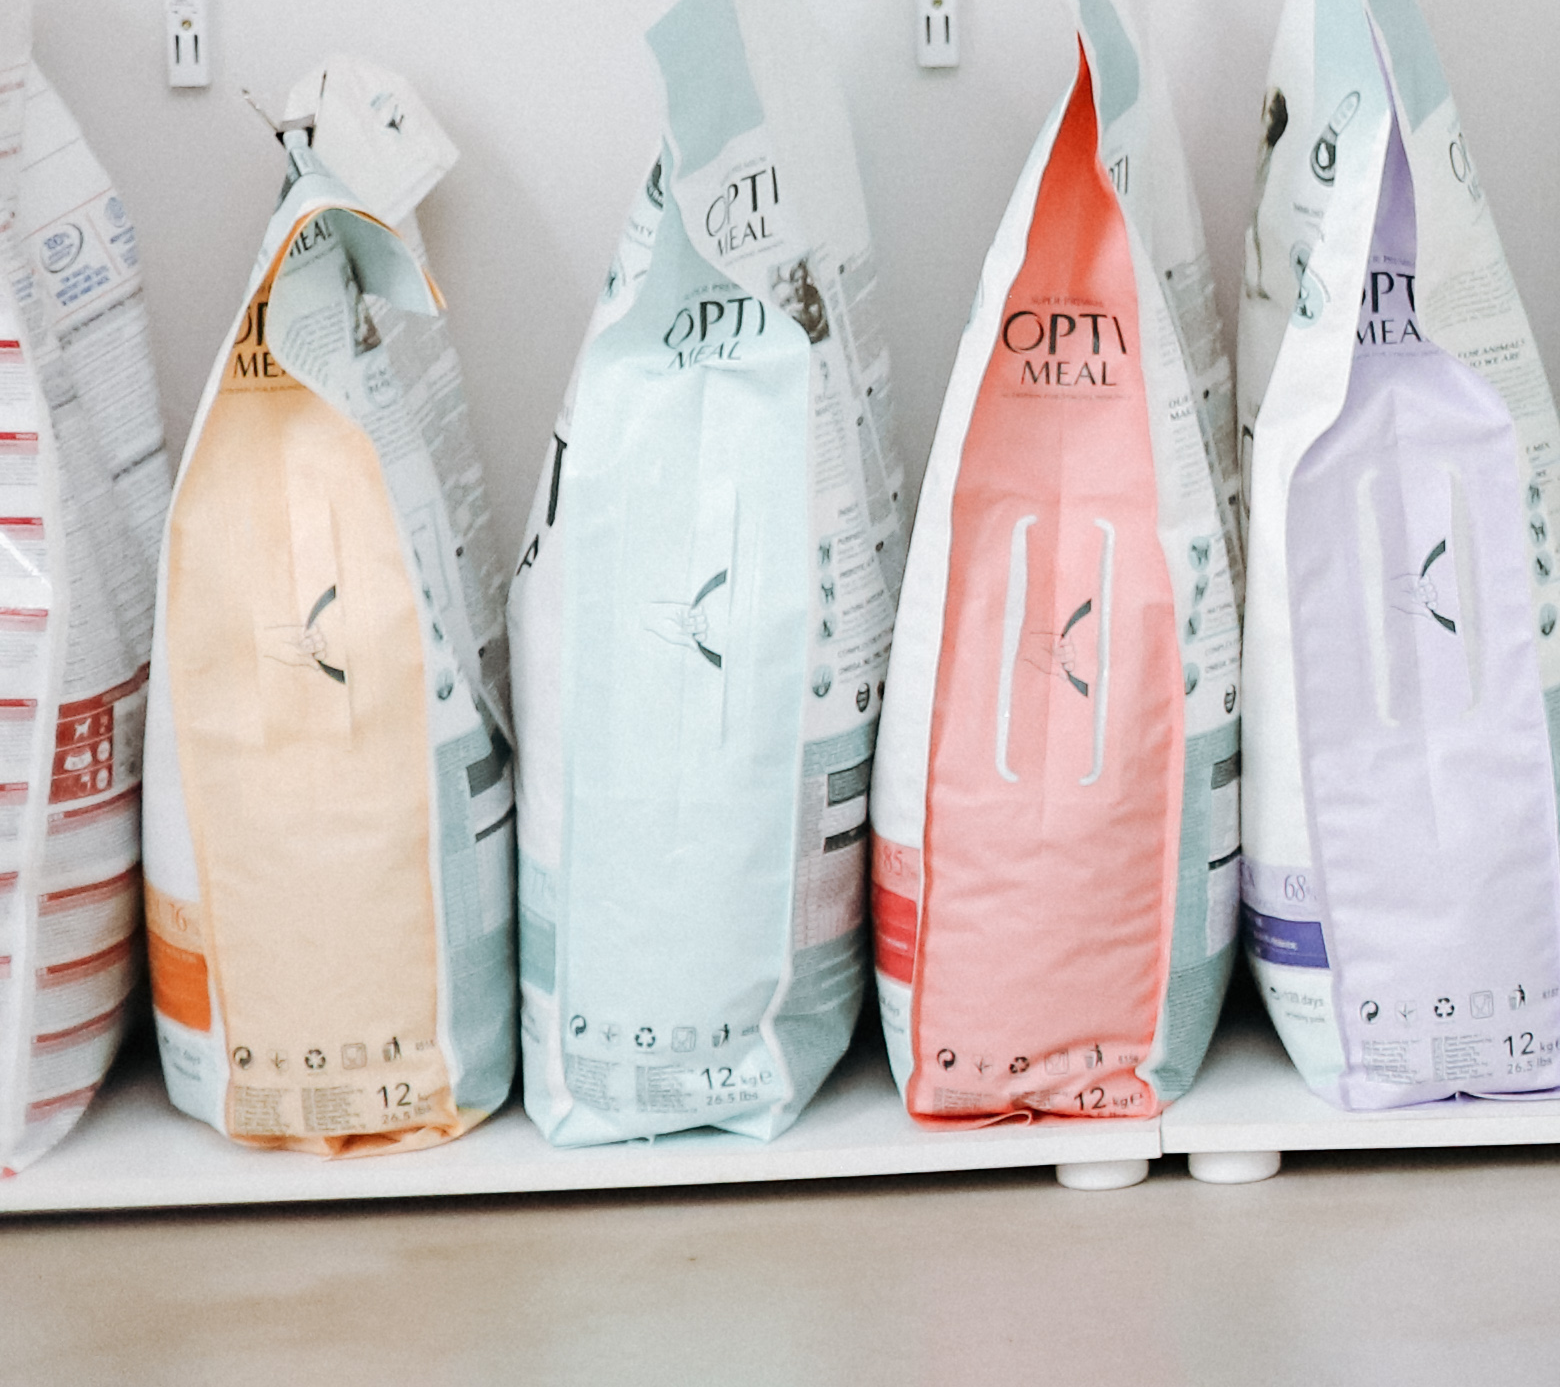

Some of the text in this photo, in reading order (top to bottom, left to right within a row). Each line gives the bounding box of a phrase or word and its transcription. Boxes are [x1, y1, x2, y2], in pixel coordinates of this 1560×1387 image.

[704, 165, 780, 234] OPTI
[716, 219, 773, 257] MEAL
[664, 297, 766, 345] OPTI
[1000, 309, 1127, 356] OPTI
[672, 340, 742, 371] MEAL
[1020, 359, 1117, 387] MEAL
[1503, 1033, 1534, 1057] 12
[701, 1068, 735, 1089] 12
[377, 1083, 411, 1107] 12
